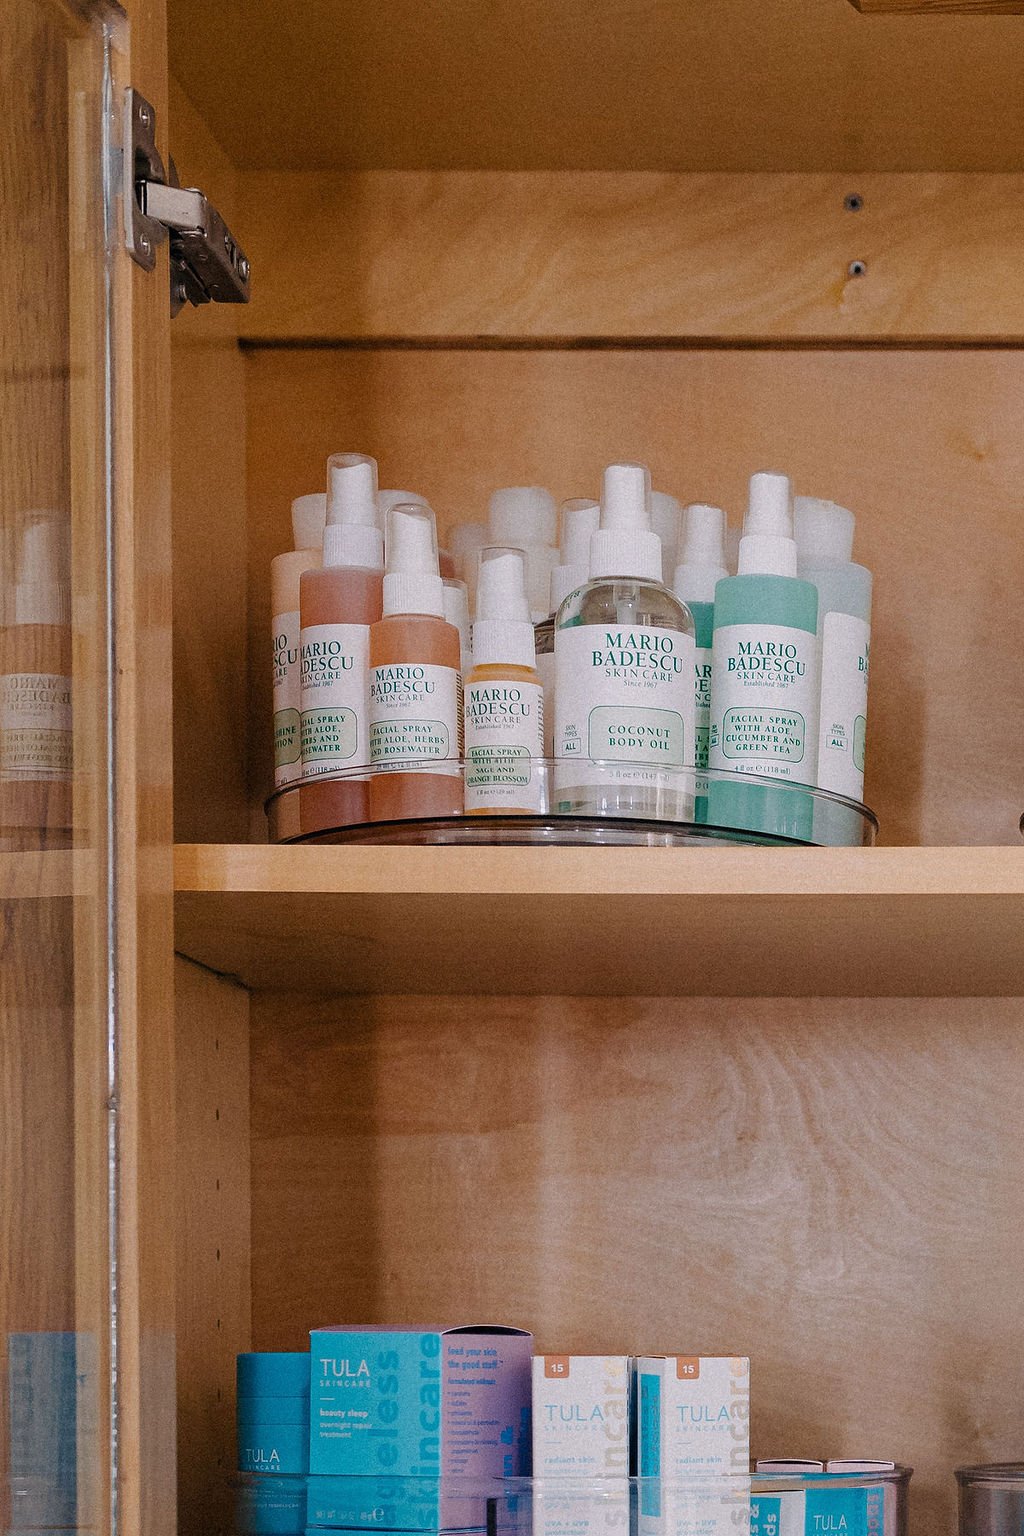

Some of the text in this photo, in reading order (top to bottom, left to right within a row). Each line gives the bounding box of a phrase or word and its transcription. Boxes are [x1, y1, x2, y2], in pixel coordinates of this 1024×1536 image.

[605, 632, 673, 654] MARIO
[738, 642, 797, 659] MARIO
[300, 656, 354, 675] ADESCU
[592, 651, 683, 674] BADESCU
[727, 658, 806, 676] BADESCU
[315, 671, 341, 680] CARE
[376, 667, 424, 682] MARIO
[605, 668, 673, 682] SKIN CARE
[737, 672, 796, 684] SKIN CARE
[371, 681, 435, 697] BADESCU
[376, 694, 396, 704] SKIN
[470, 689, 521, 703] MARIO
[466, 702, 530, 718] BADESCU
[318, 716, 346, 724] SPRAY
[471, 716, 520, 725] SKIN CARE
[769, 716, 798, 726] SPRAY
[373, 726, 399, 736] FACIAL
[608, 725, 671, 738] COCONUT
[764, 726, 793, 736] ALOE,
[384, 736, 445, 744] ALOE, HERBS
[609, 738, 670, 750] BODY OIL
[726, 734, 779, 743] CUCUMBER
[783, 737, 801, 747] AND
[831, 739, 844, 747] ALL
[384, 746, 440, 754] ROSEWATER
[774, 745, 791, 754] TEA
[319, 1358, 370, 1377] TULA
[551, 1364, 564, 1373] 15
[682, 1365, 695, 1374] 15
[544, 1404, 604, 1422] TULA
[676, 1405, 730, 1422] TULA
[246, 1448, 280, 1463] TULA
[813, 1514, 848, 1531] TULA
